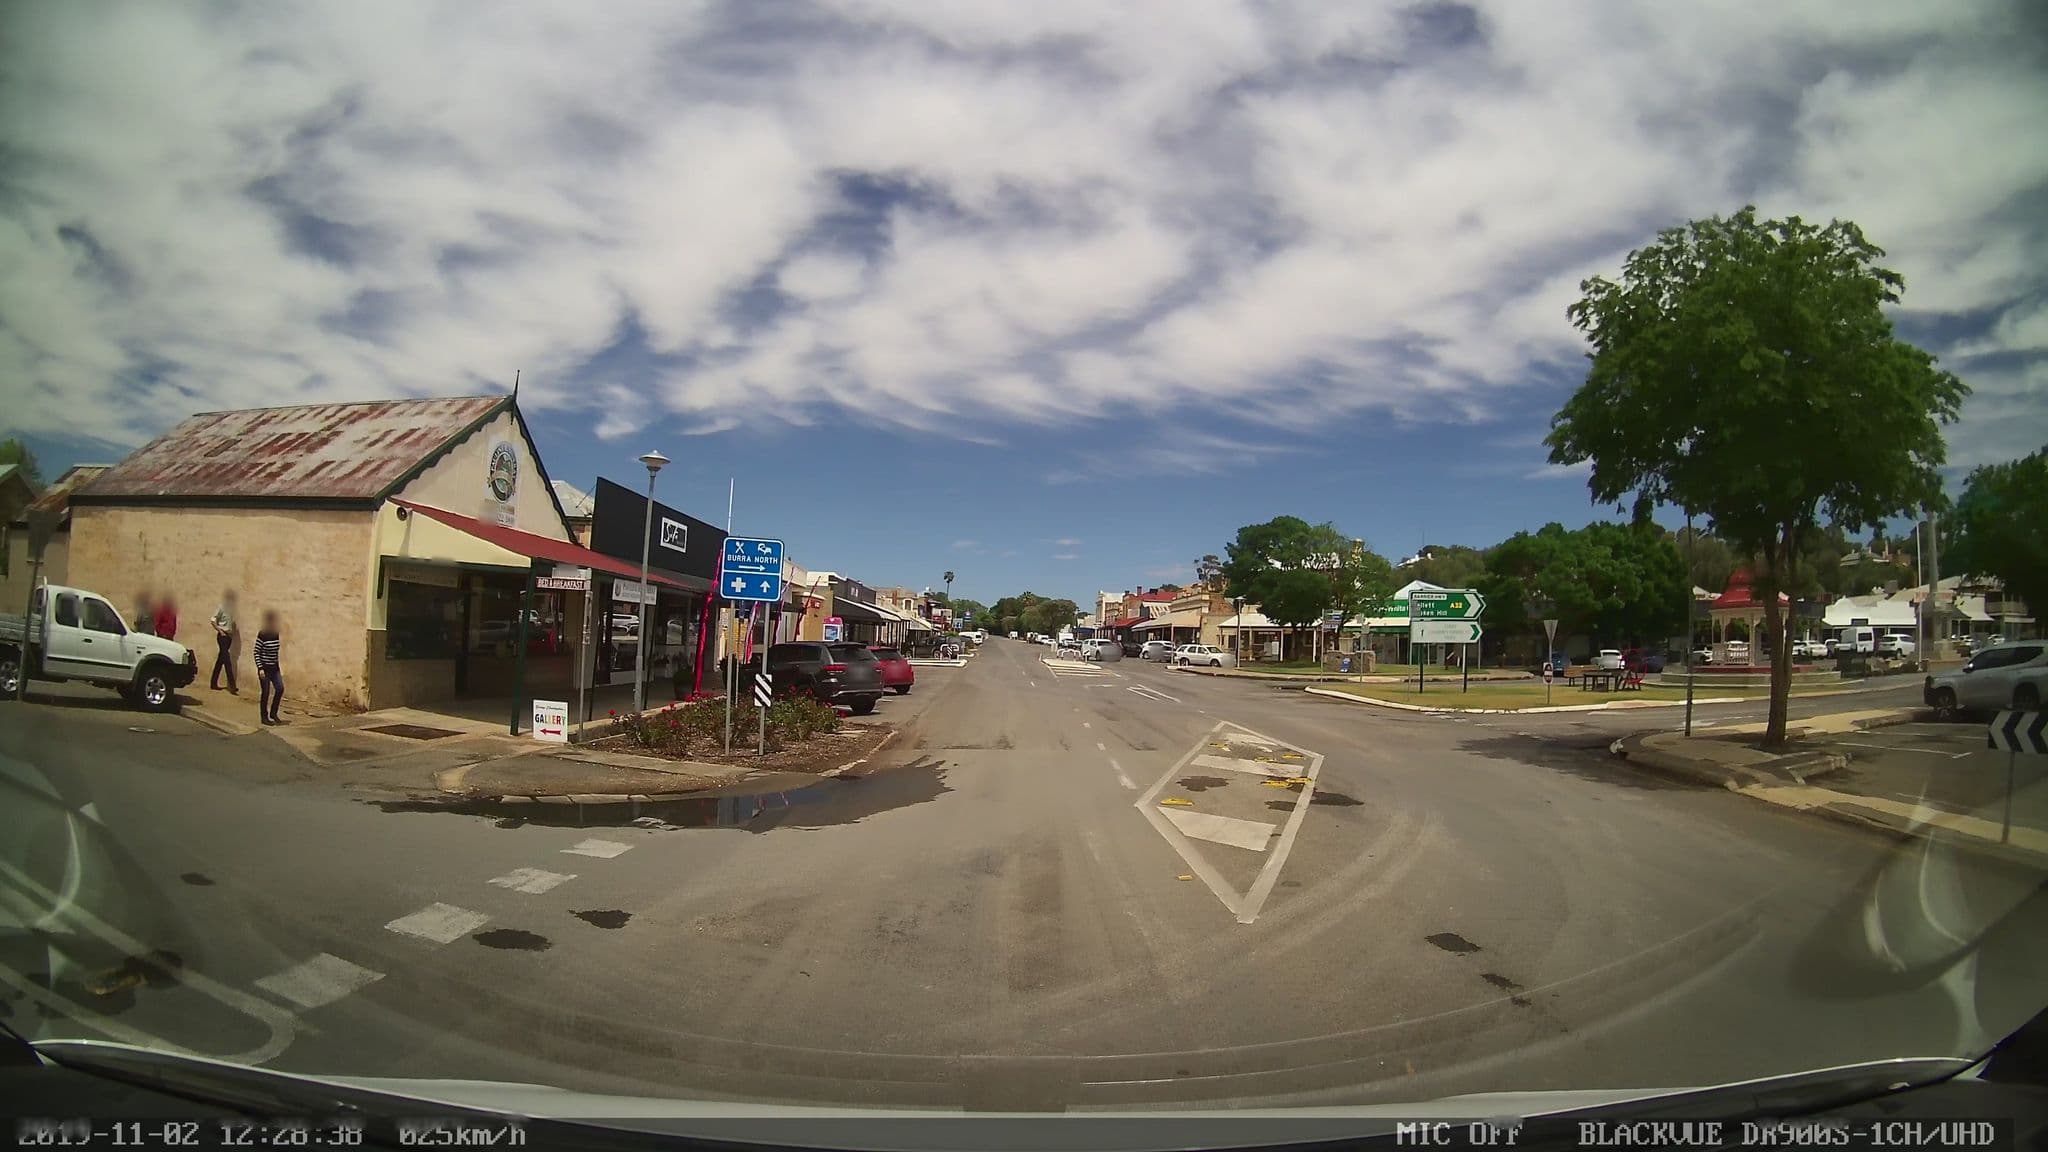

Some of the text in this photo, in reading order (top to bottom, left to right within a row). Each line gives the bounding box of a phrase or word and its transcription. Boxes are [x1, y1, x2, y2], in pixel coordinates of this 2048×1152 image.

[727, 554, 778, 565] BURRA NORTH
[535, 713, 566, 726] GALLERY
